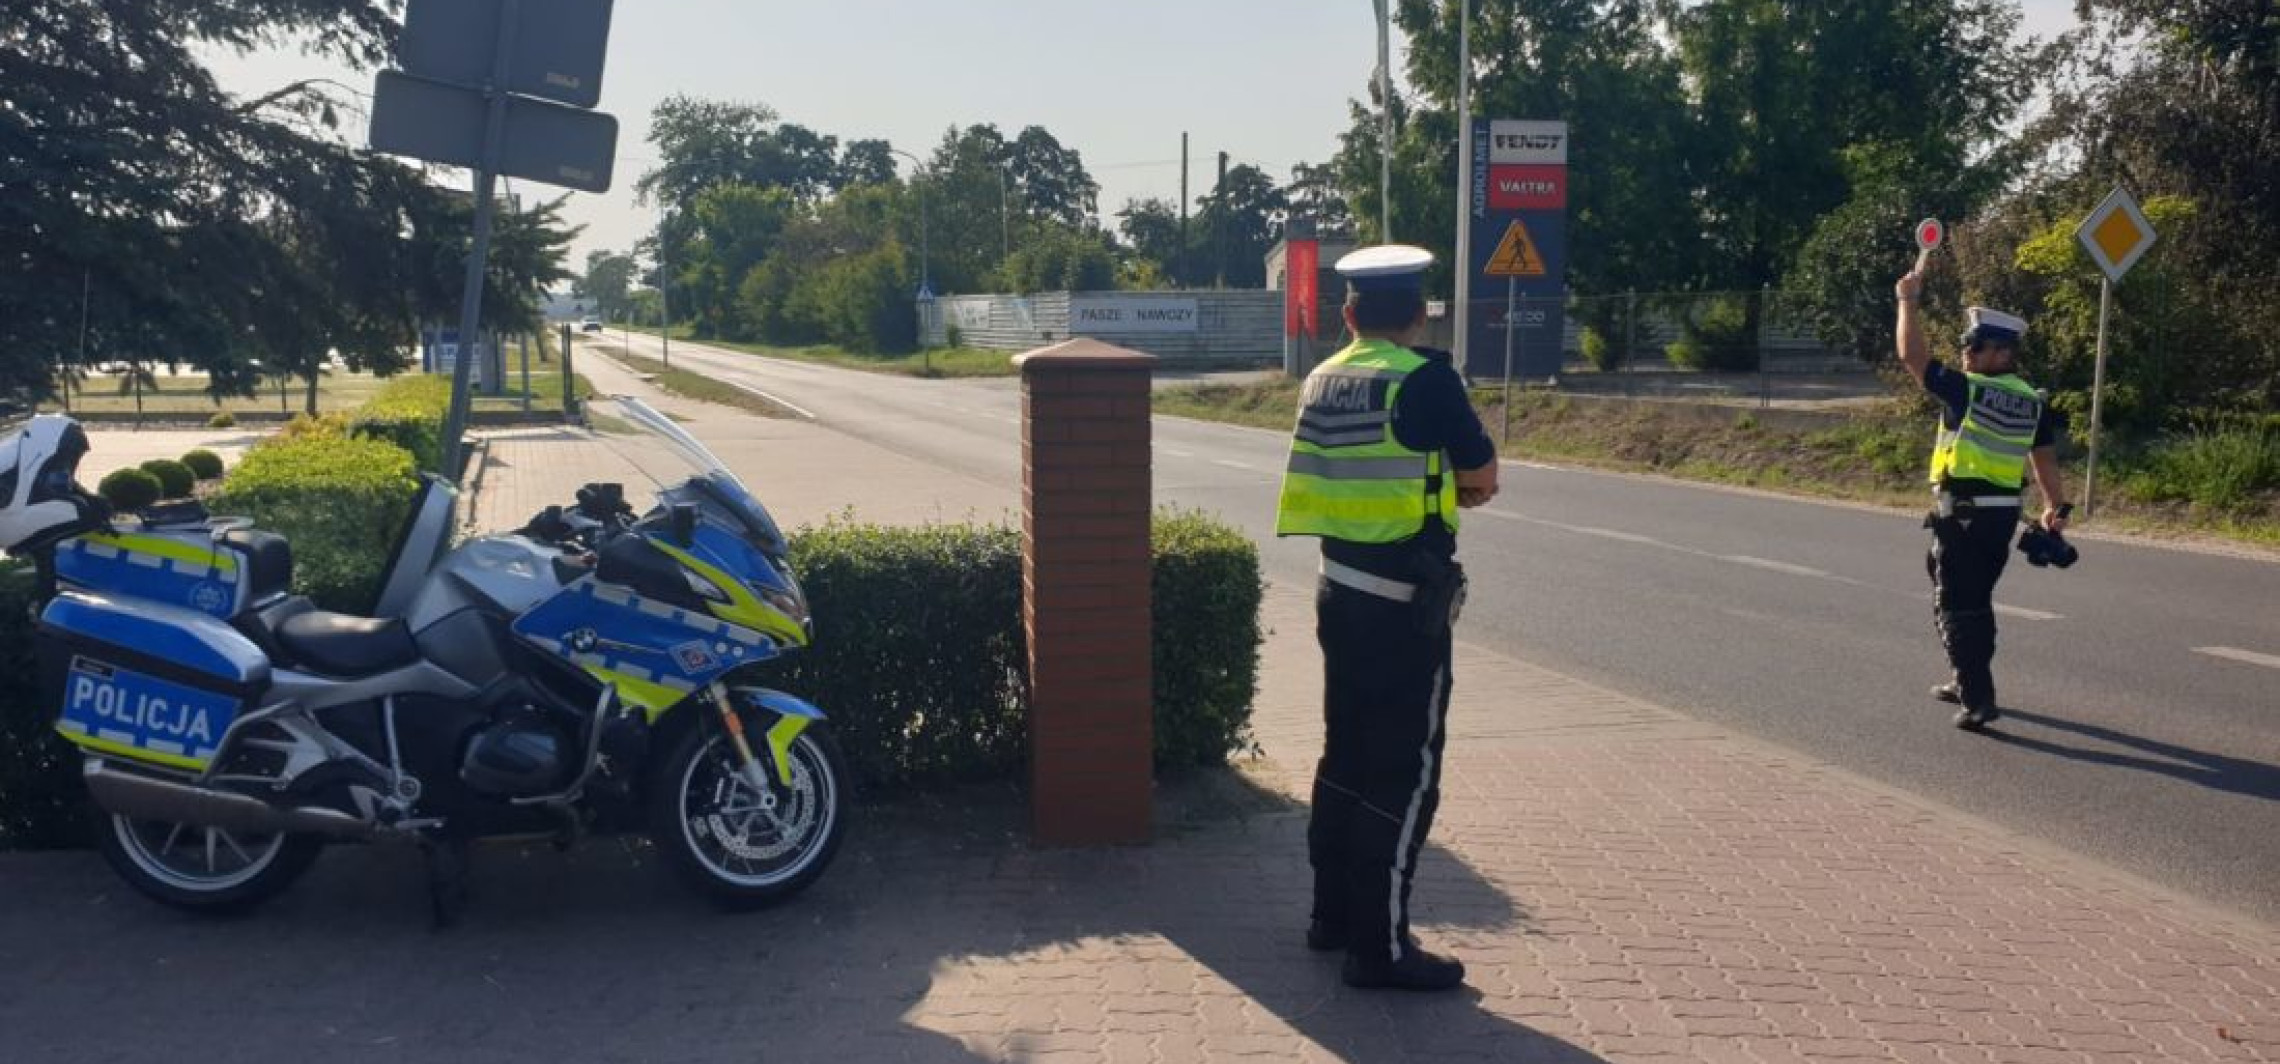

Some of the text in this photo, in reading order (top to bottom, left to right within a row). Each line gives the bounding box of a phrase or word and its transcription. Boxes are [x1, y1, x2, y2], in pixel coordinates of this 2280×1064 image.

[1495, 134, 1563, 149] FENDT
[1080, 308, 1193, 321] PASZE NAWOZY
[72, 676, 211, 743] POLICJA
